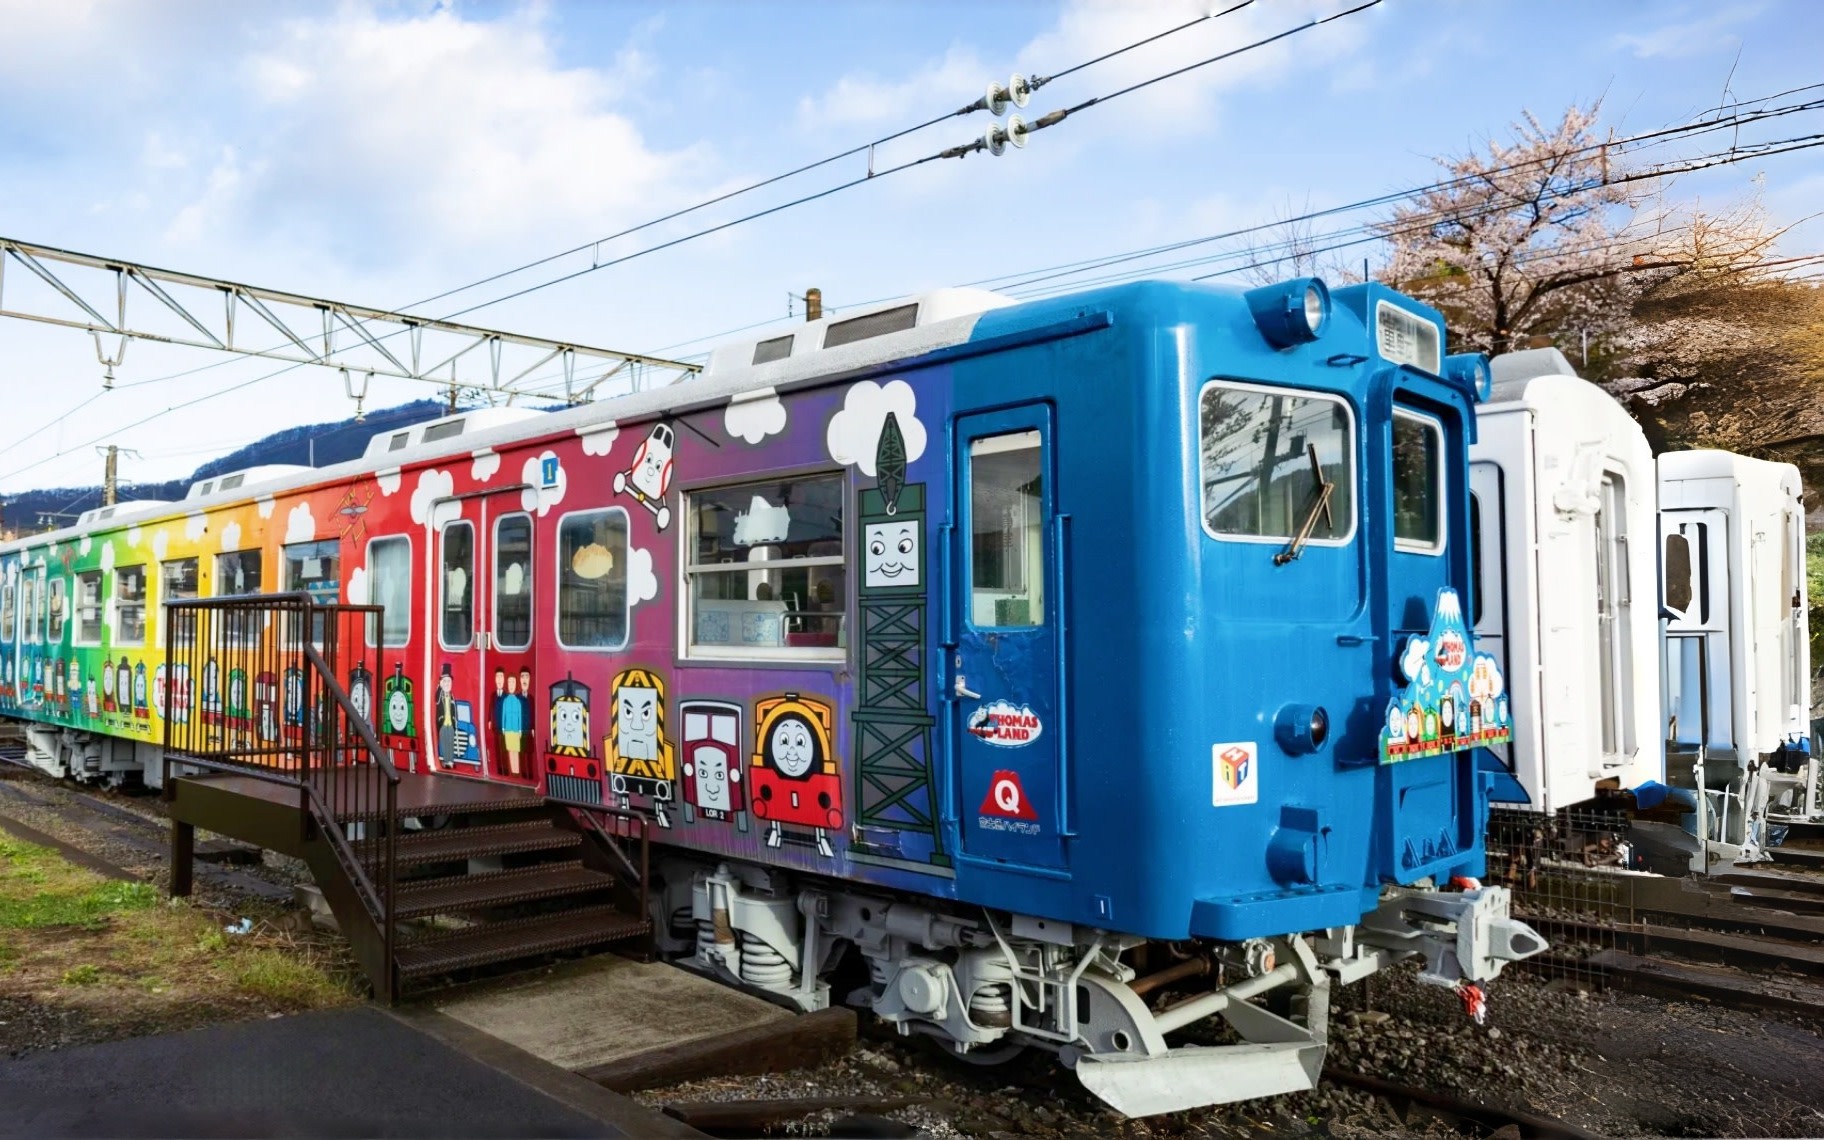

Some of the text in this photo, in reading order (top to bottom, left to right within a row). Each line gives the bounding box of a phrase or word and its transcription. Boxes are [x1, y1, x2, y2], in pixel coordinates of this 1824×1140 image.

[547, 462, 553, 480] 1
[989, 713, 1038, 728] THOMAS
[997, 727, 1029, 740] LAND
[995, 780, 1020, 814] Q
[705, 808, 725, 820] LOR 2
